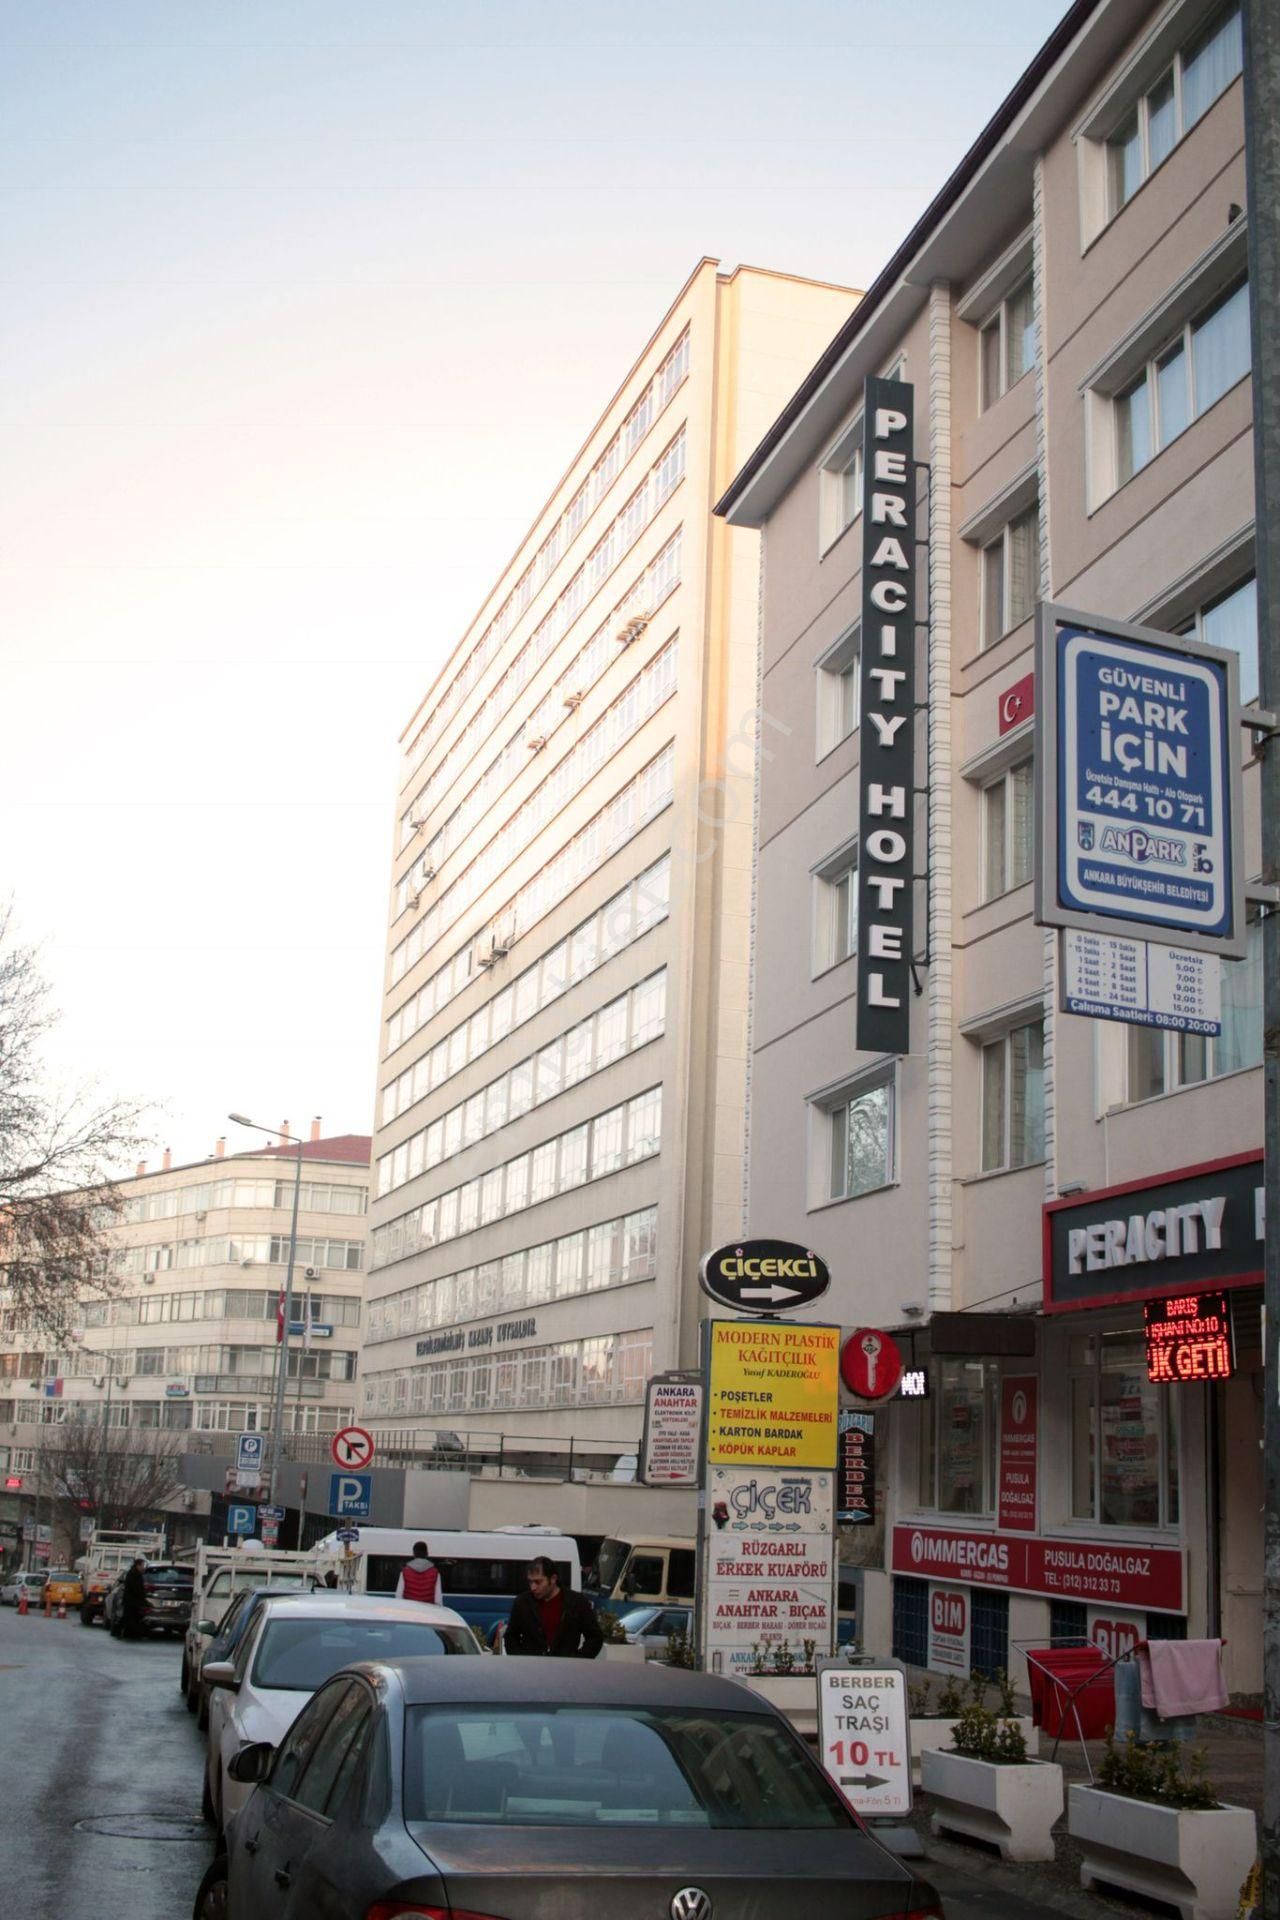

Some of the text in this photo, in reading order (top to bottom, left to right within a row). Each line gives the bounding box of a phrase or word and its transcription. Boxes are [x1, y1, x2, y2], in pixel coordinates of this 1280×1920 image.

[869, 408, 909, 746] PERACITY
[1098, 668, 1185, 701] GÜVENLİ
[1100, 691, 1188, 735] PARK
[1101, 721, 1187, 778] İÇİN
[1086, 786, 1204, 827] 444 10 71
[866, 782, 906, 1008] HOTEL
[1083, 869, 1208, 902] ANKARA BÜYÜKŞEHİR BELEDİYESİ
[1169, 951, 1203, 964] Ücretsiz
[1071, 1000, 1216, 1033] Çalışma Saatleri: 08:00 20:00
[1068, 1197, 1227, 1275] PERACITY
[720, 1249, 817, 1281] ÇİÇEKCİ
[717, 1331, 835, 1349] MODERN PLASTİK
[738, 1348, 817, 1367] KAĞITÇILIK
[743, 1368, 820, 1379] Yusuf KADEROĞLU
[657, 1387, 695, 1396] ANKARA
[721, 1391, 773, 1403] POŞETLER
[654, 1398, 697, 1407] ANAHTAR
[720, 1408, 833, 1423] TEMİZLİK MALZEMELERİ
[719, 1426, 803, 1439] KARTON BARDAK
[718, 1442, 796, 1456] KÖPÜK KAPLAR
[845, 1432, 869, 1508] BERBER
[731, 1480, 811, 1520] ÇİÇEK
[742, 1539, 807, 1556] RÜZGARLI
[924, 1537, 1009, 1570] IMMERGAS
[716, 1561, 828, 1577] ERKEK KUAFÖRÜ
[1045, 1549, 1150, 1576] PUSULA DOĞALGAZ
[1045, 1571, 1121, 1593] TEL: (312) 312 33 73
[748, 1590, 799, 1602] ANKARA
[716, 1604, 778, 1617] ANAHTAR
[789, 1605, 826, 1620] BIÇAK
[935, 1594, 962, 1629] BİM
[713, 1621, 731, 1631] BIÇAK
[829, 1676, 895, 1688] BERBER
[842, 1695, 880, 1713] SAÇ
[835, 1715, 889, 1734] TRAŞI
[829, 1740, 901, 1766] 10 TL
[884, 1795, 891, 1805] 5
